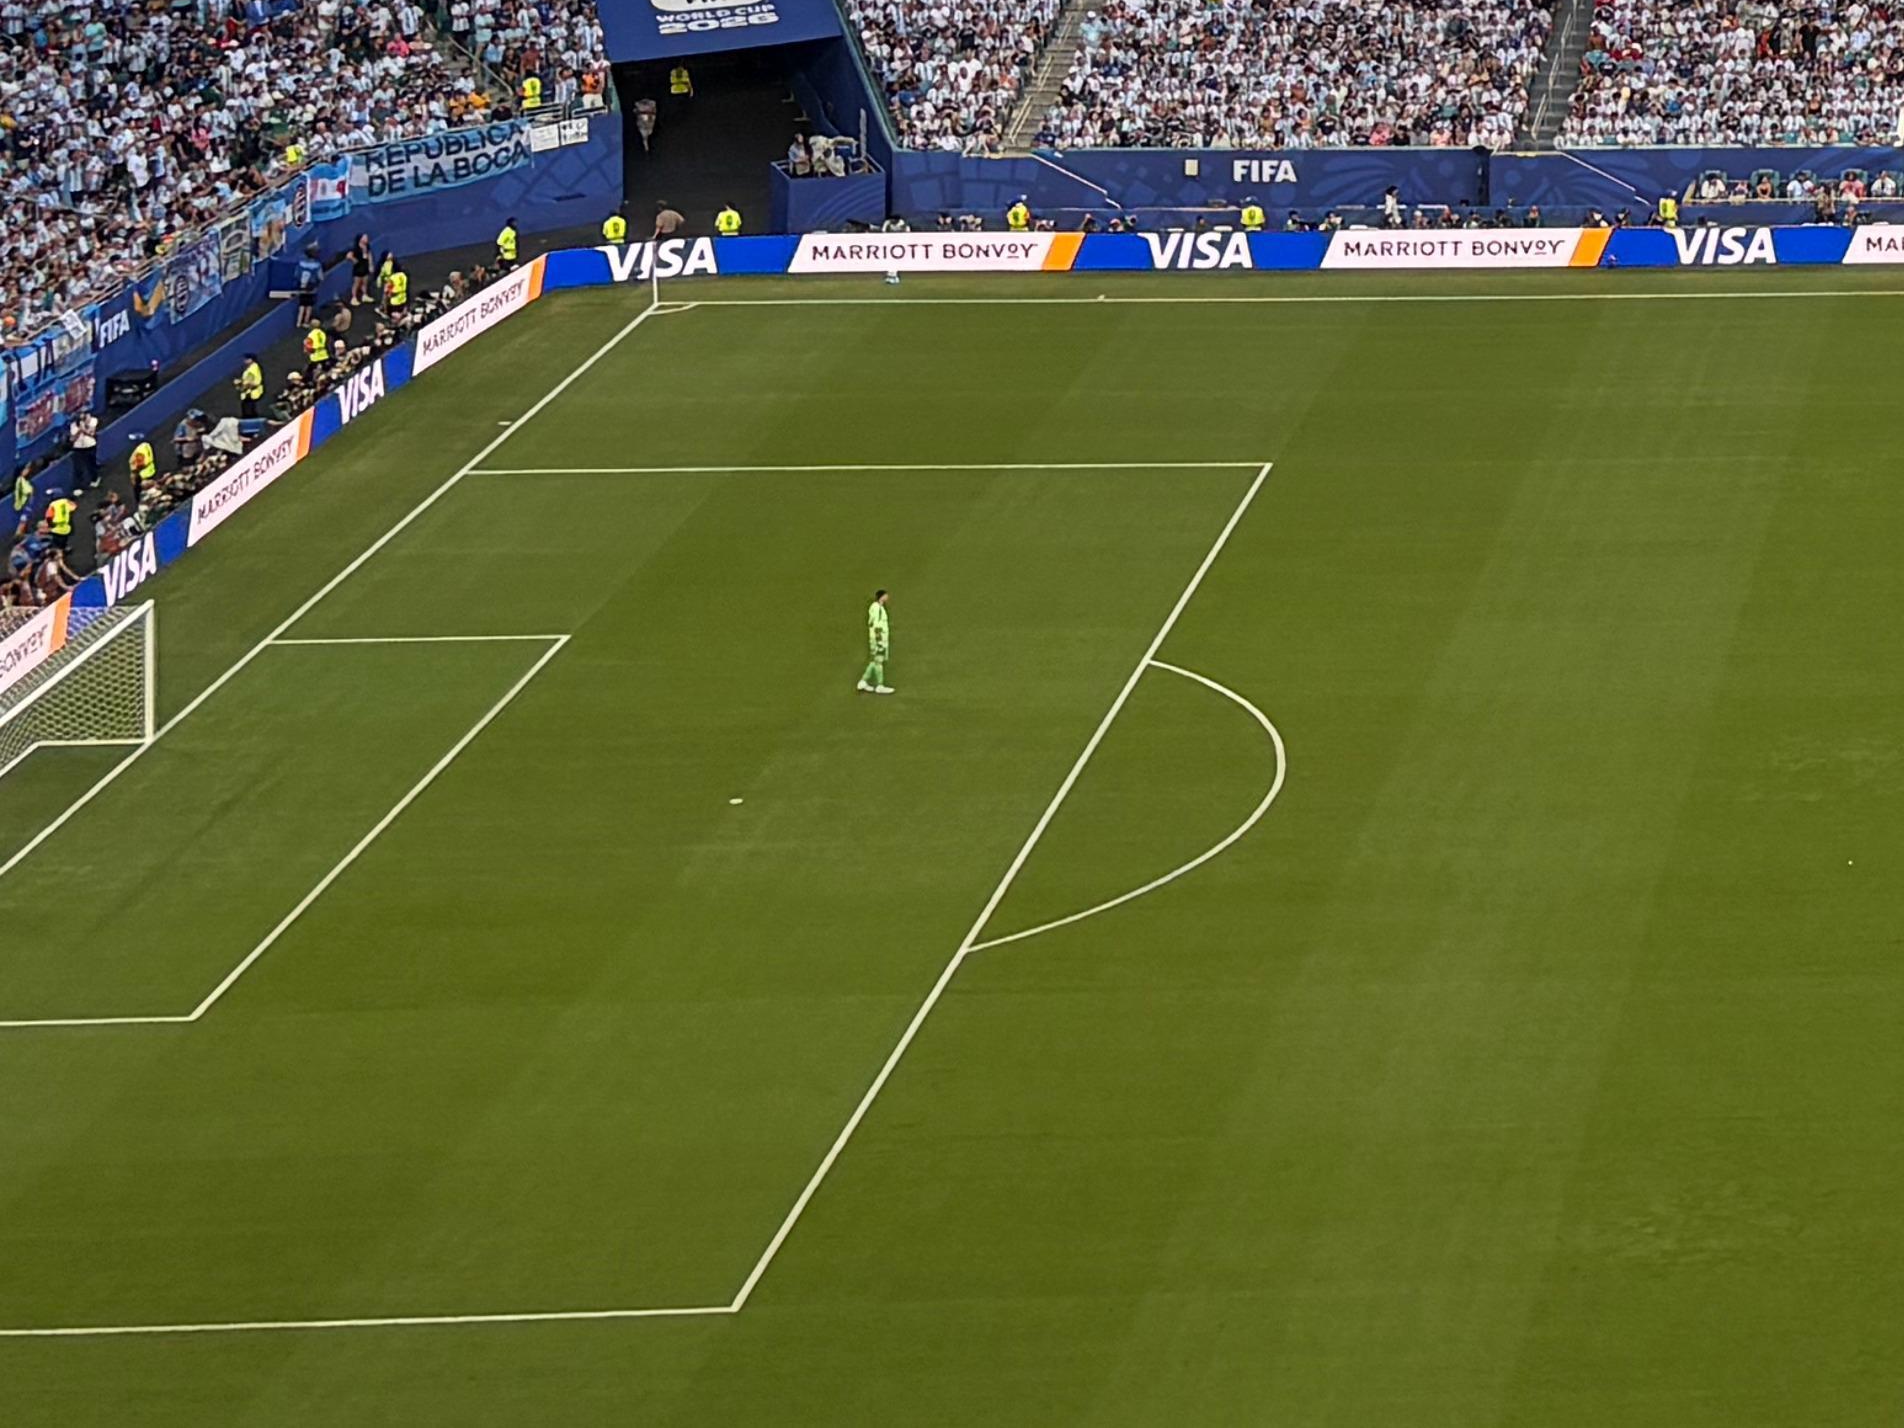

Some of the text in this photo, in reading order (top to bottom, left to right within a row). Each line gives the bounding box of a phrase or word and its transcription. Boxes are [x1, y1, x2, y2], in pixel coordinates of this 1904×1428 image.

[655, 3, 776, 23] WORLD CUP
[658, 11, 780, 35] 2026
[364, 122, 525, 173] REPUBLICA
[367, 139, 531, 198] DE LA BOCA
[1232, 159, 1298, 184] FIFA
[603, 237, 719, 282] VISA
[811, 242, 934, 262] MARRIOTT
[1143, 231, 1253, 270] VISA
[1343, 239, 1465, 258] MARRIOTT
[1672, 227, 1778, 266] VISA
[99, 308, 131, 349] FIFA
[422, 305, 478, 358] MARRIOTT
[339, 358, 386, 424] VISA
[196, 465, 252, 526] MARRIOTT
[102, 532, 157, 606] VISA
